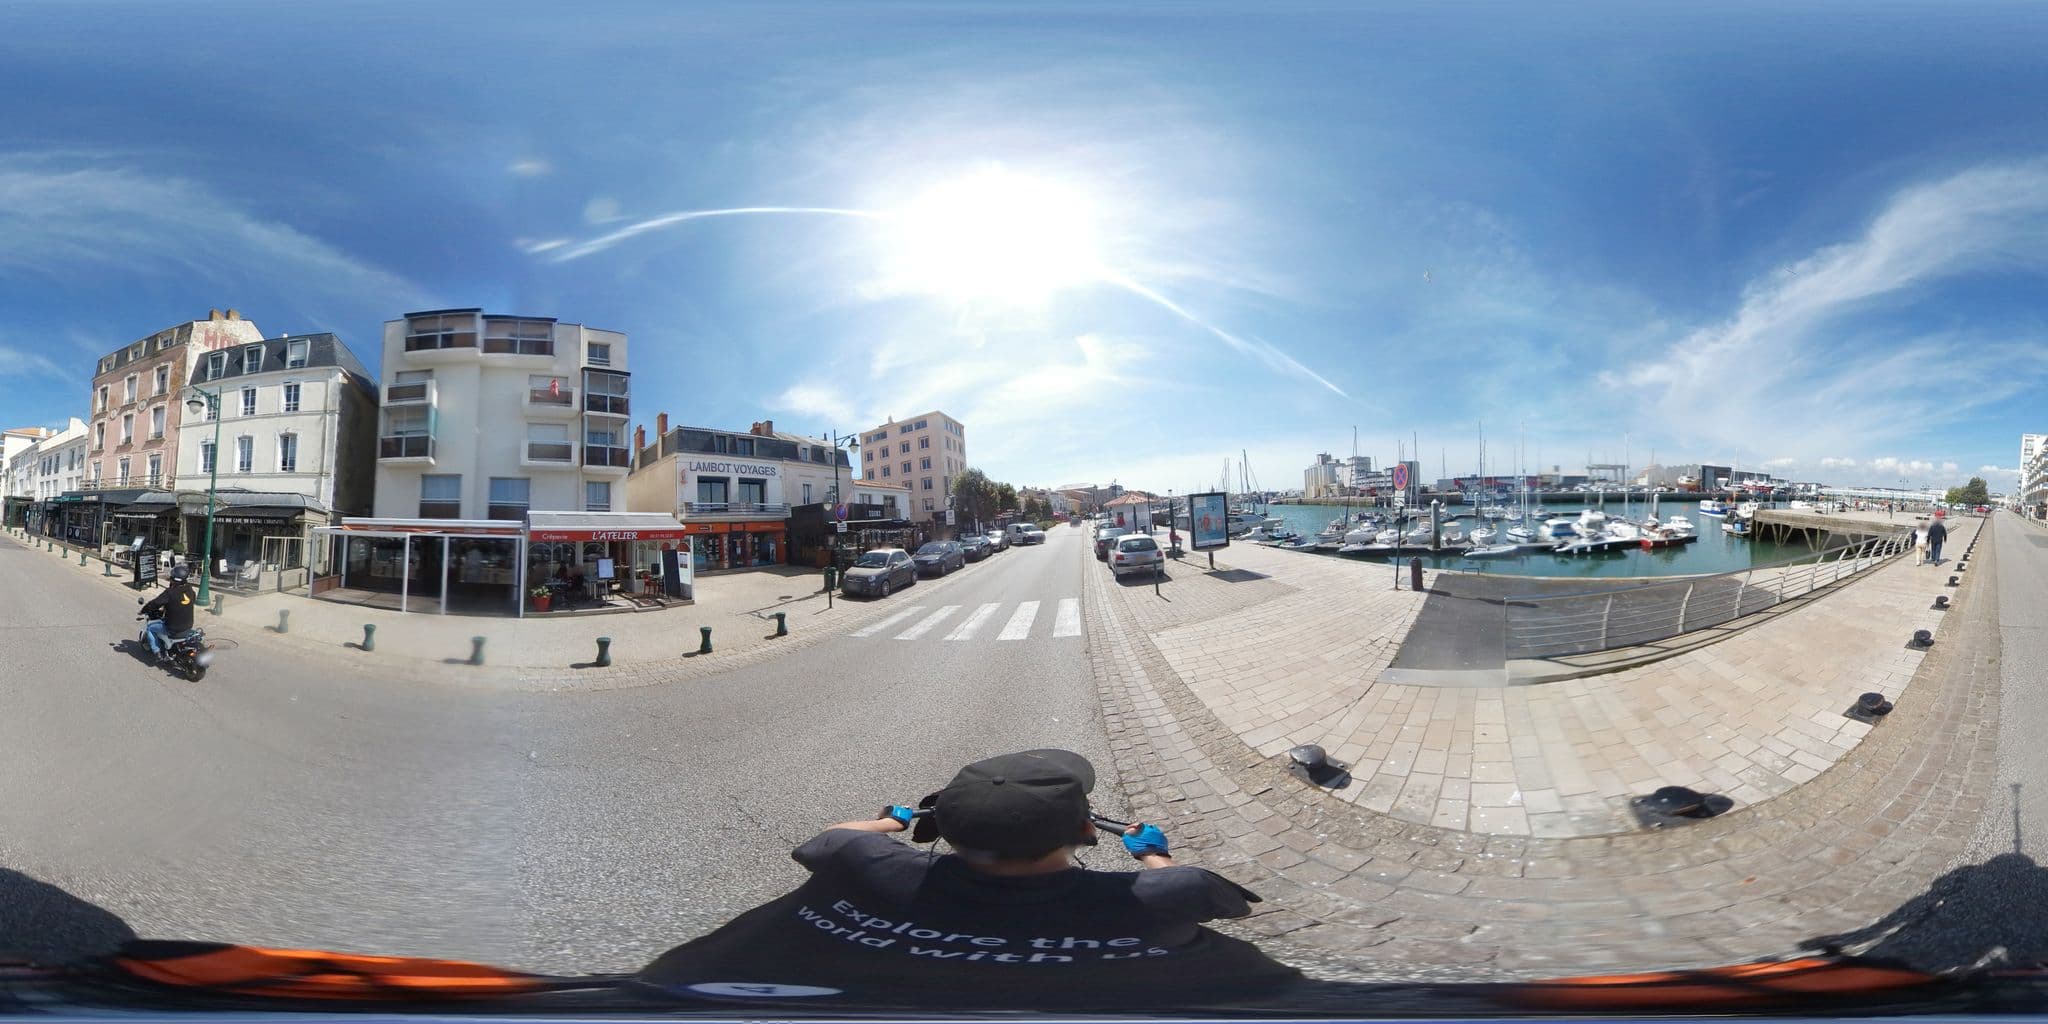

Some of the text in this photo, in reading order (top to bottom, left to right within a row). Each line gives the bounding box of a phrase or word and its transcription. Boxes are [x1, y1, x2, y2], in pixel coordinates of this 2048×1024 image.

[689, 461, 776, 476] LAMBOT VOYAGES
[592, 531, 638, 540] L'ATELIER
[797, 905, 1169, 963] world with us
[831, 899, 1143, 949] Explore the
